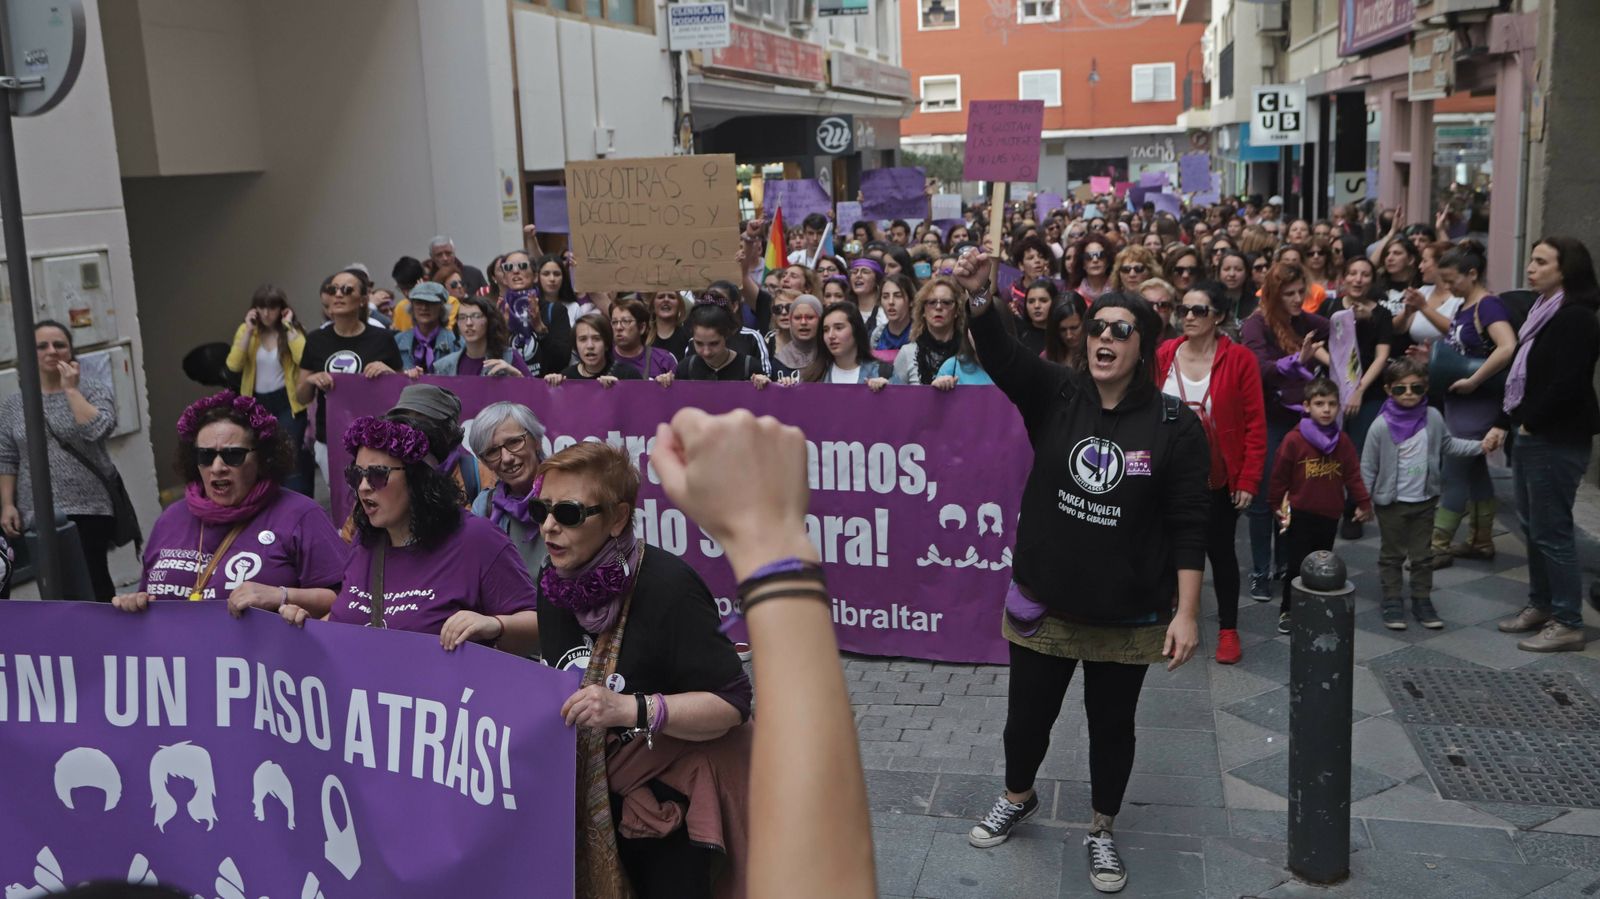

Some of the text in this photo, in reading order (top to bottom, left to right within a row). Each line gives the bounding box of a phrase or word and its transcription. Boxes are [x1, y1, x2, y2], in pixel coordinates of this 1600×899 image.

[572, 164, 682, 200] NOSOTRAS
[578, 201, 721, 226] DECIDIMOS Y
[1087, 500, 1121, 518] VIOLETA
[148, 570, 168, 582] SIN
[147, 583, 217, 600] RESPUETA
[103, 655, 188, 727] UN
[215, 656, 332, 752] PASO
[343, 687, 517, 811] ATRÁS!
